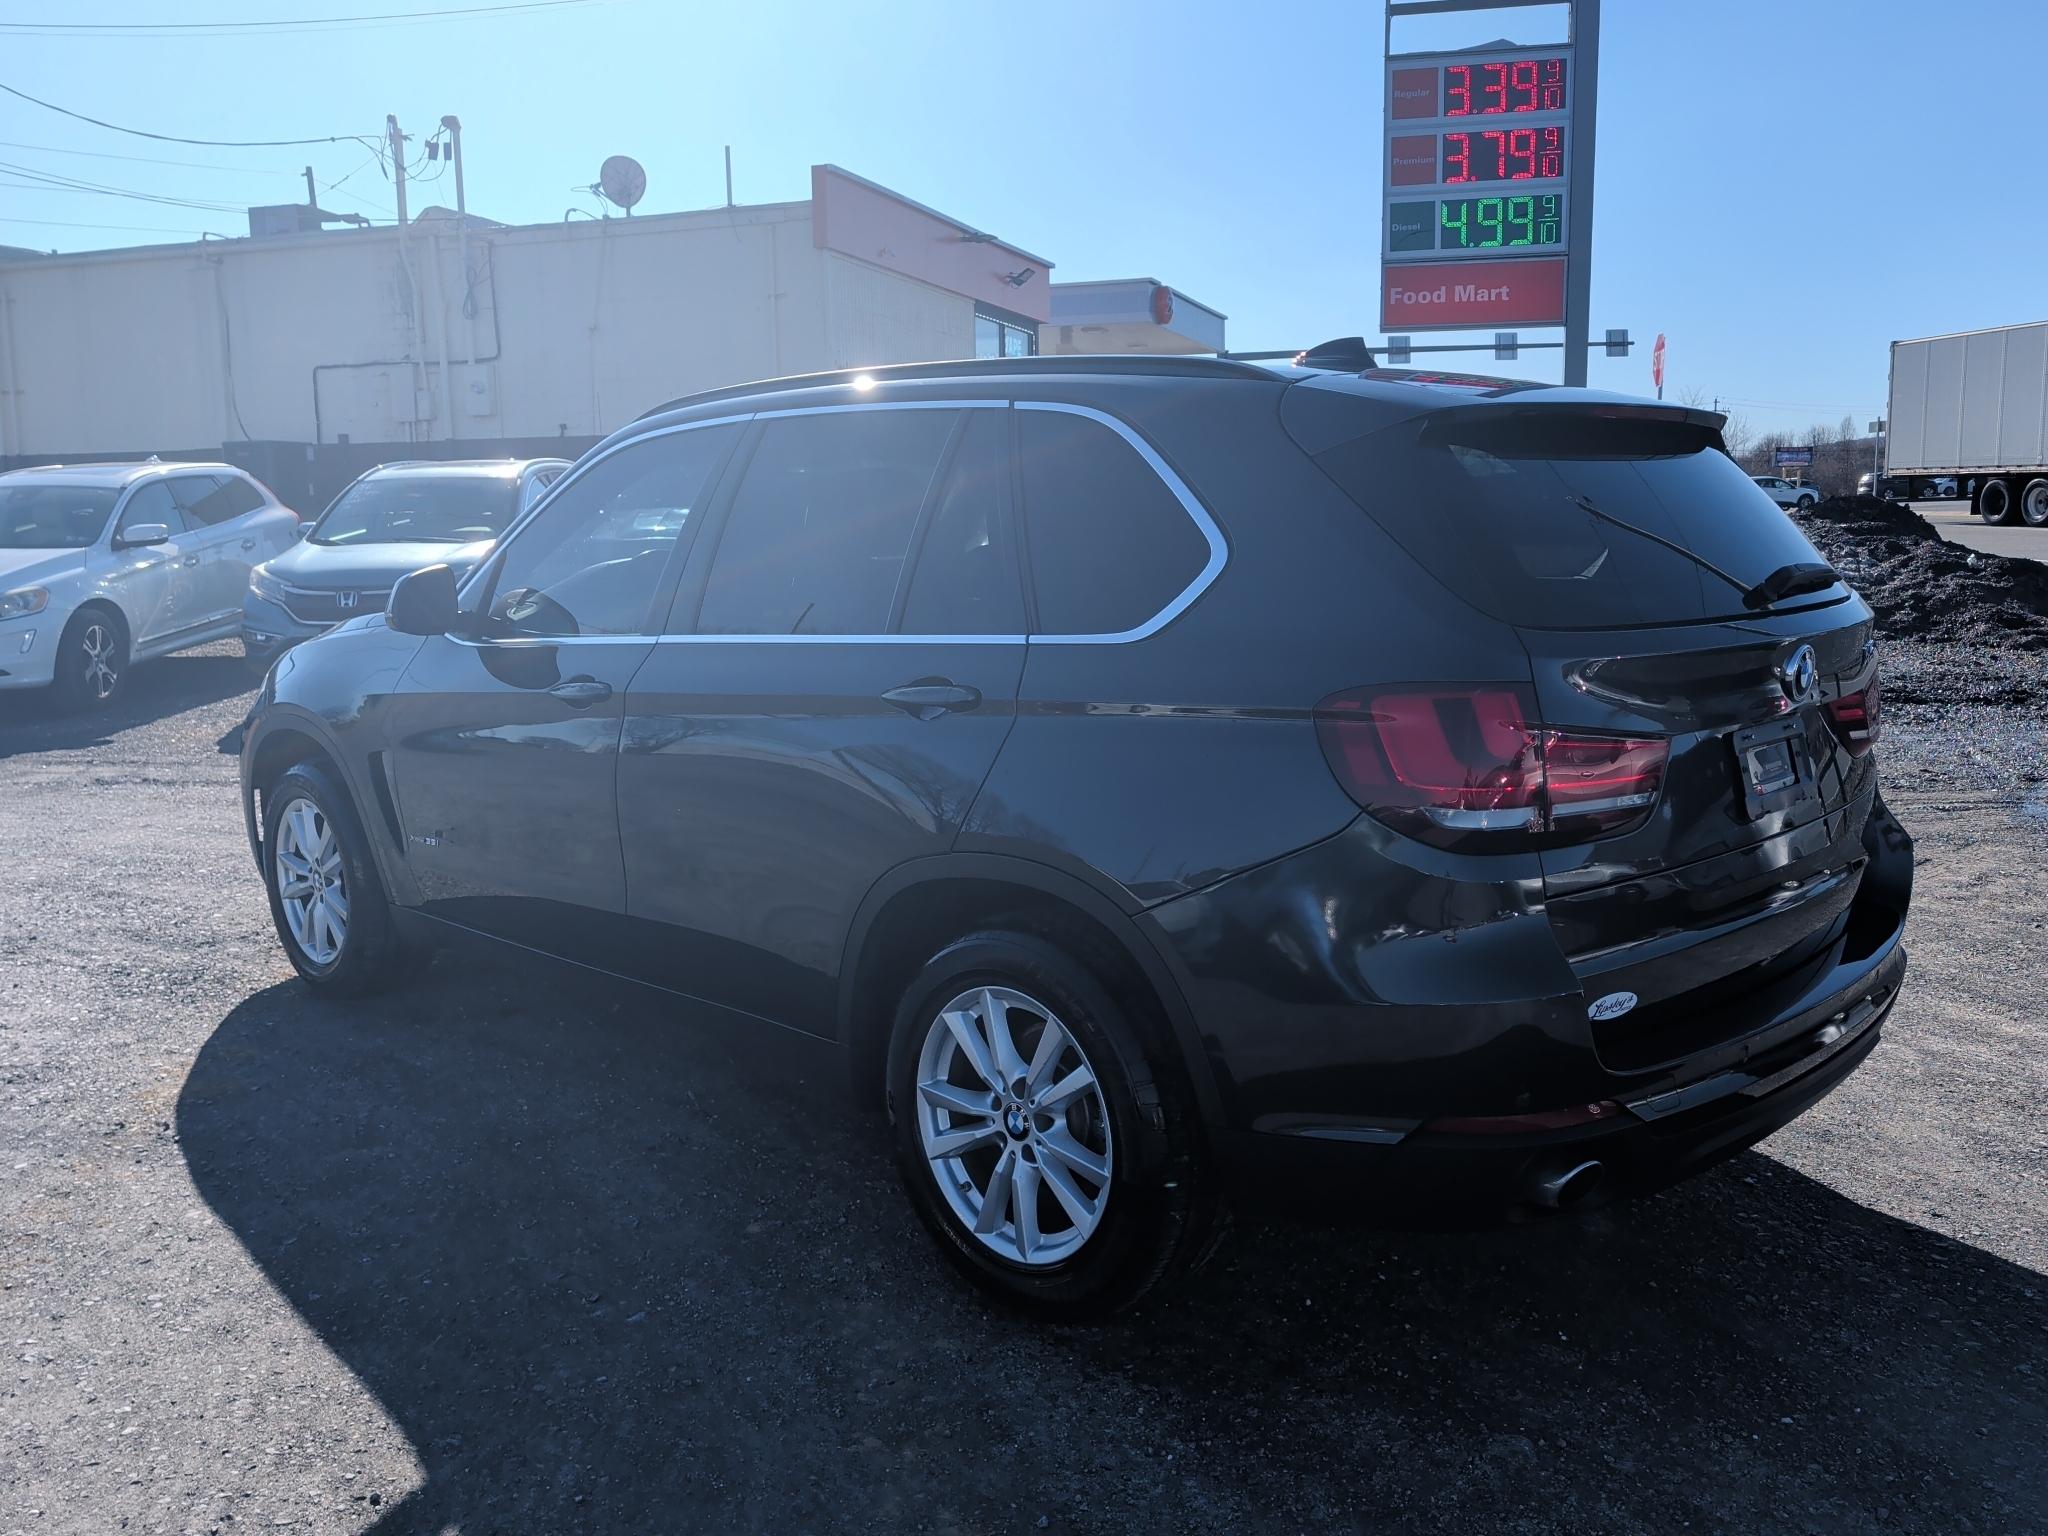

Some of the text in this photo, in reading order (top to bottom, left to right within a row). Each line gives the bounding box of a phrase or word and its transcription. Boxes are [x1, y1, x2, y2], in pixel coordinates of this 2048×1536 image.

[1393, 89, 1431, 99] Regular
[1446, 61, 1539, 116] 3.39
[1392, 155, 1435, 166] Premium
[1445, 128, 1537, 184] 3.79
[1391, 222, 1421, 232] Diesel
[1440, 196, 1534, 248] 4.99
[1390, 284, 1510, 305] Food Mart
